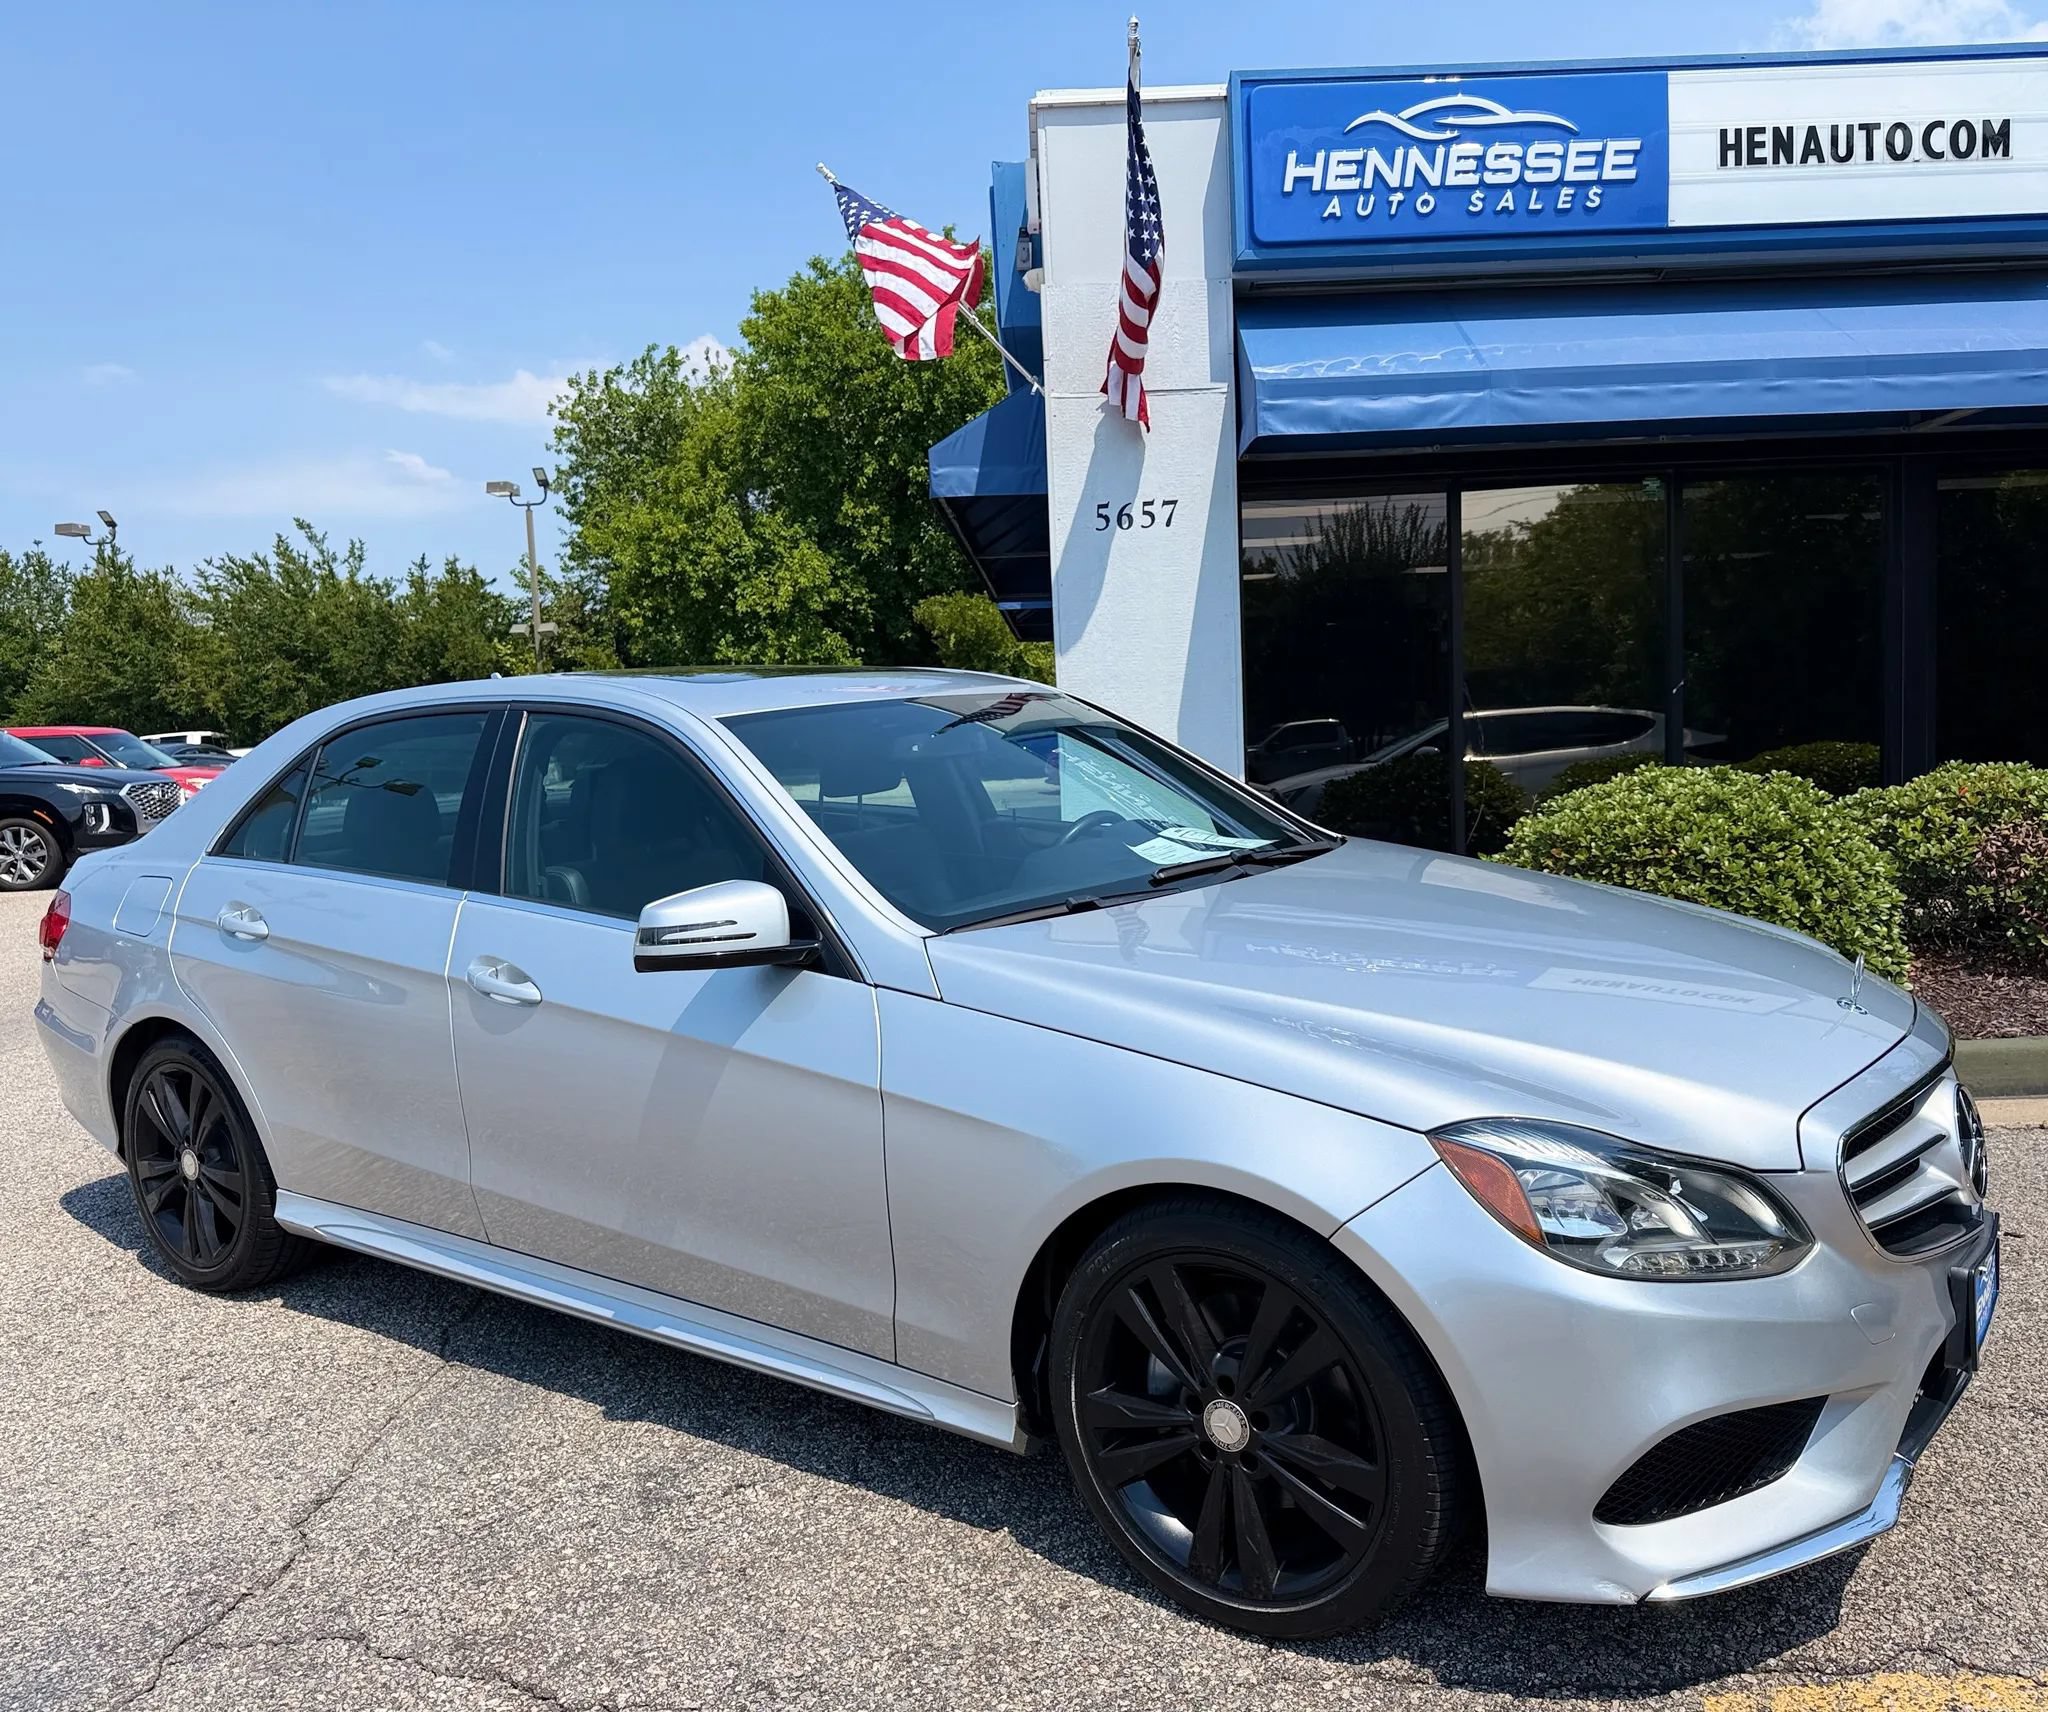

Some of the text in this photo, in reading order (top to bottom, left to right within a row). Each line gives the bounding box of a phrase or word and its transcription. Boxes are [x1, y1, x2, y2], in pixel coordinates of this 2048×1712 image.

[1283, 137, 1642, 193] HENNESSEE
[1322, 185, 1604, 218] AUTO SALES
[1095, 498, 1179, 532] 5657
